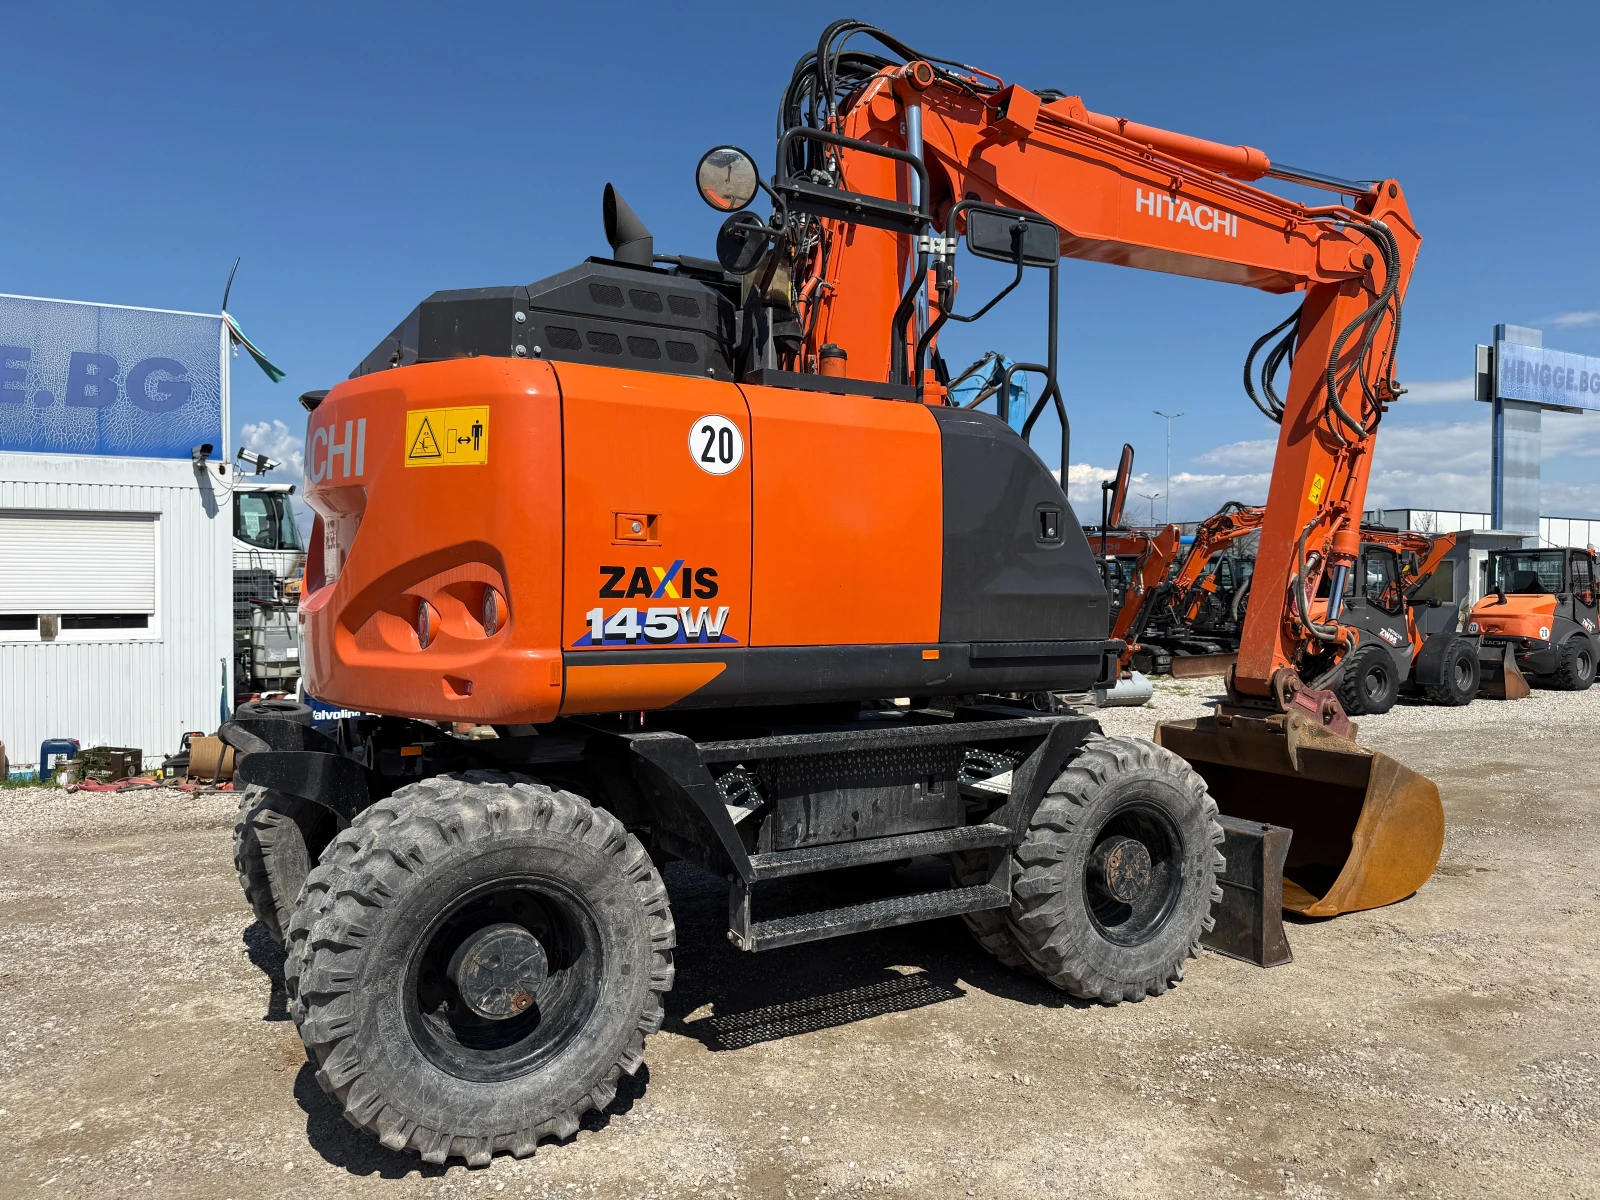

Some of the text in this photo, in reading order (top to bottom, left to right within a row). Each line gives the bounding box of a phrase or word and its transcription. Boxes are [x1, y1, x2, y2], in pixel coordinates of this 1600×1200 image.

[1136, 188, 1238, 238] HITACHI
[1502, 358, 1600, 395] HENGGE.BG
[307, 418, 367, 484] CHI
[701, 425, 734, 464] 20
[599, 559, 719, 600] ZAXIS
[586, 606, 730, 645] 145W
[1469, 623, 1477, 632] 20
